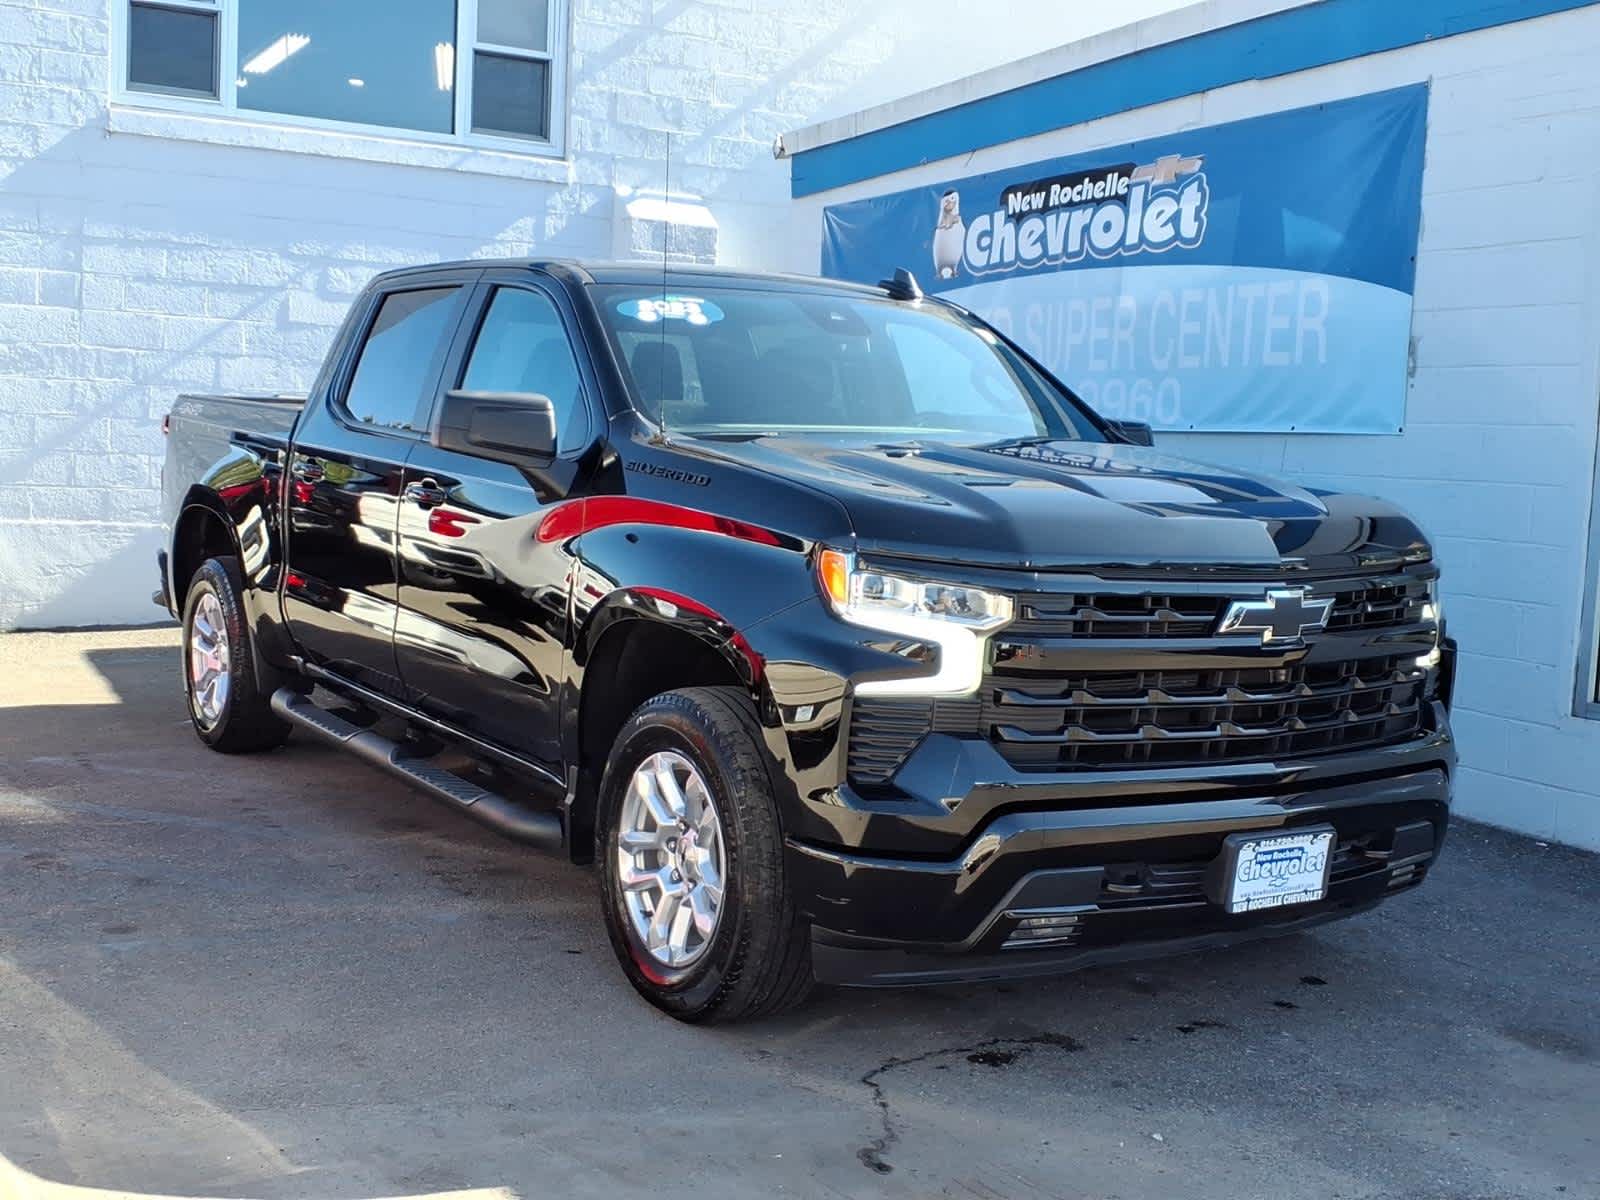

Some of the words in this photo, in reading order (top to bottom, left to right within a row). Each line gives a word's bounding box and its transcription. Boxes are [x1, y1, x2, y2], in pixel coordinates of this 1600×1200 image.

[1008, 191, 1046, 215] New
[1049, 172, 1130, 207] Rochelle
[965, 181, 1203, 268] Chevrolet
[1023, 295, 1136, 371] SUPER
[1148, 278, 1329, 371] CENTER
[625, 461, 713, 487] SILVERADO
[1238, 852, 1324, 882] Chevrolet
